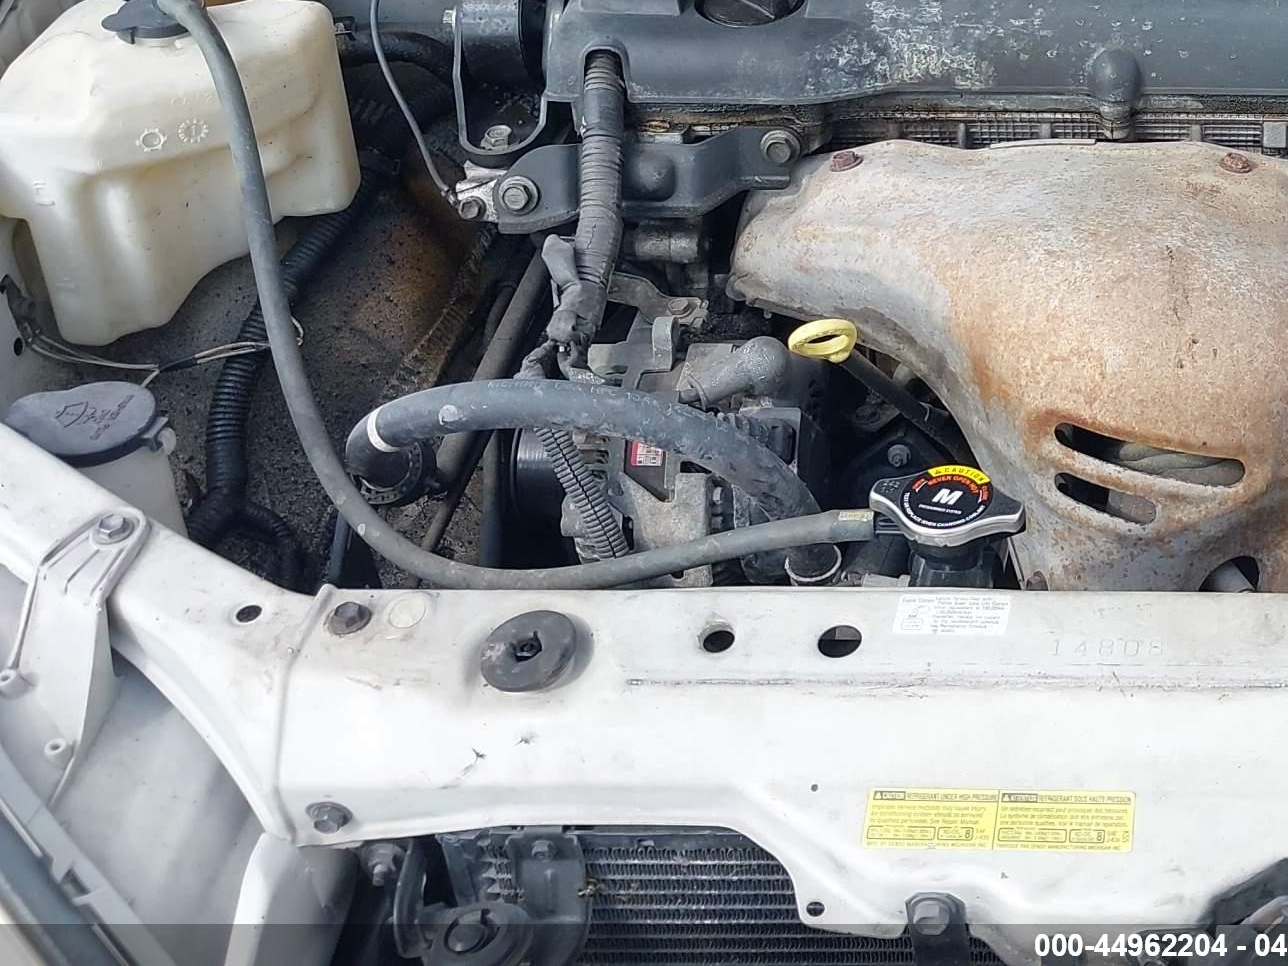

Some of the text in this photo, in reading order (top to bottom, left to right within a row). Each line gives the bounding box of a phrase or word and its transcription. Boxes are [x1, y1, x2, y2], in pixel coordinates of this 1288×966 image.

[945, 467, 986, 482] CAUTION
[927, 475, 952, 486] NEVER
[953, 475, 973, 485] OPEN
[931, 488, 964, 506] M
[964, 829, 971, 839] 8
[1096, 831, 1103, 842] 8
